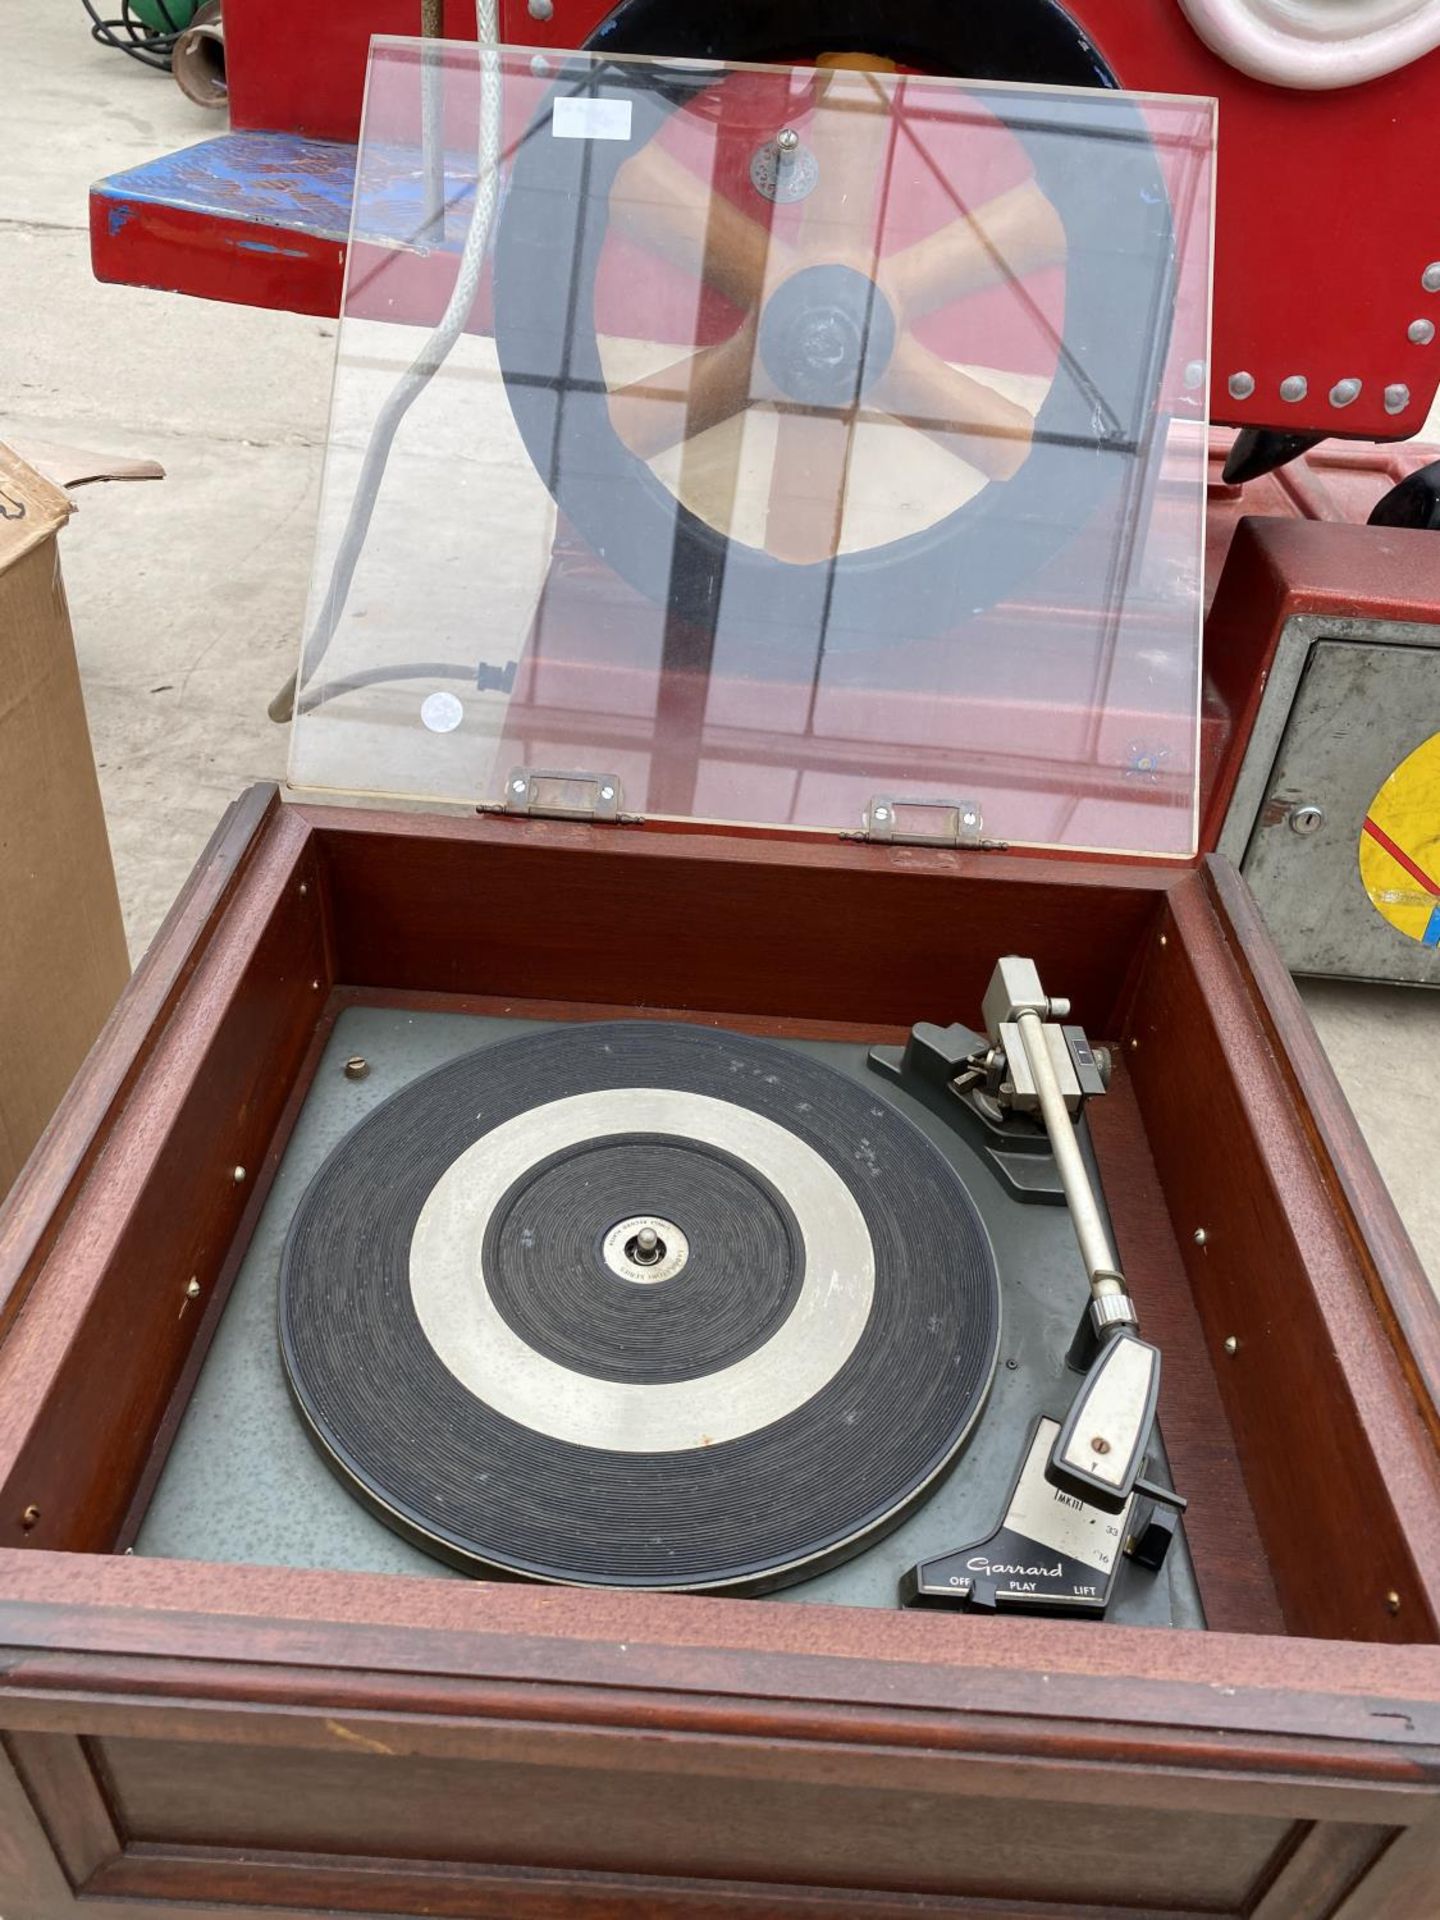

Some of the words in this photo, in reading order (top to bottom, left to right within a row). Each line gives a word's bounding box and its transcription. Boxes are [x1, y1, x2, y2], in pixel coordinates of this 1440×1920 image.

[1105, 1525, 1118, 1537] 33
[966, 1557, 1063, 1577] Garrard
[949, 1576, 971, 1586] OFF
[1009, 1581, 1037, 1592] PLAY
[1073, 1585, 1097, 1596] LIFT
